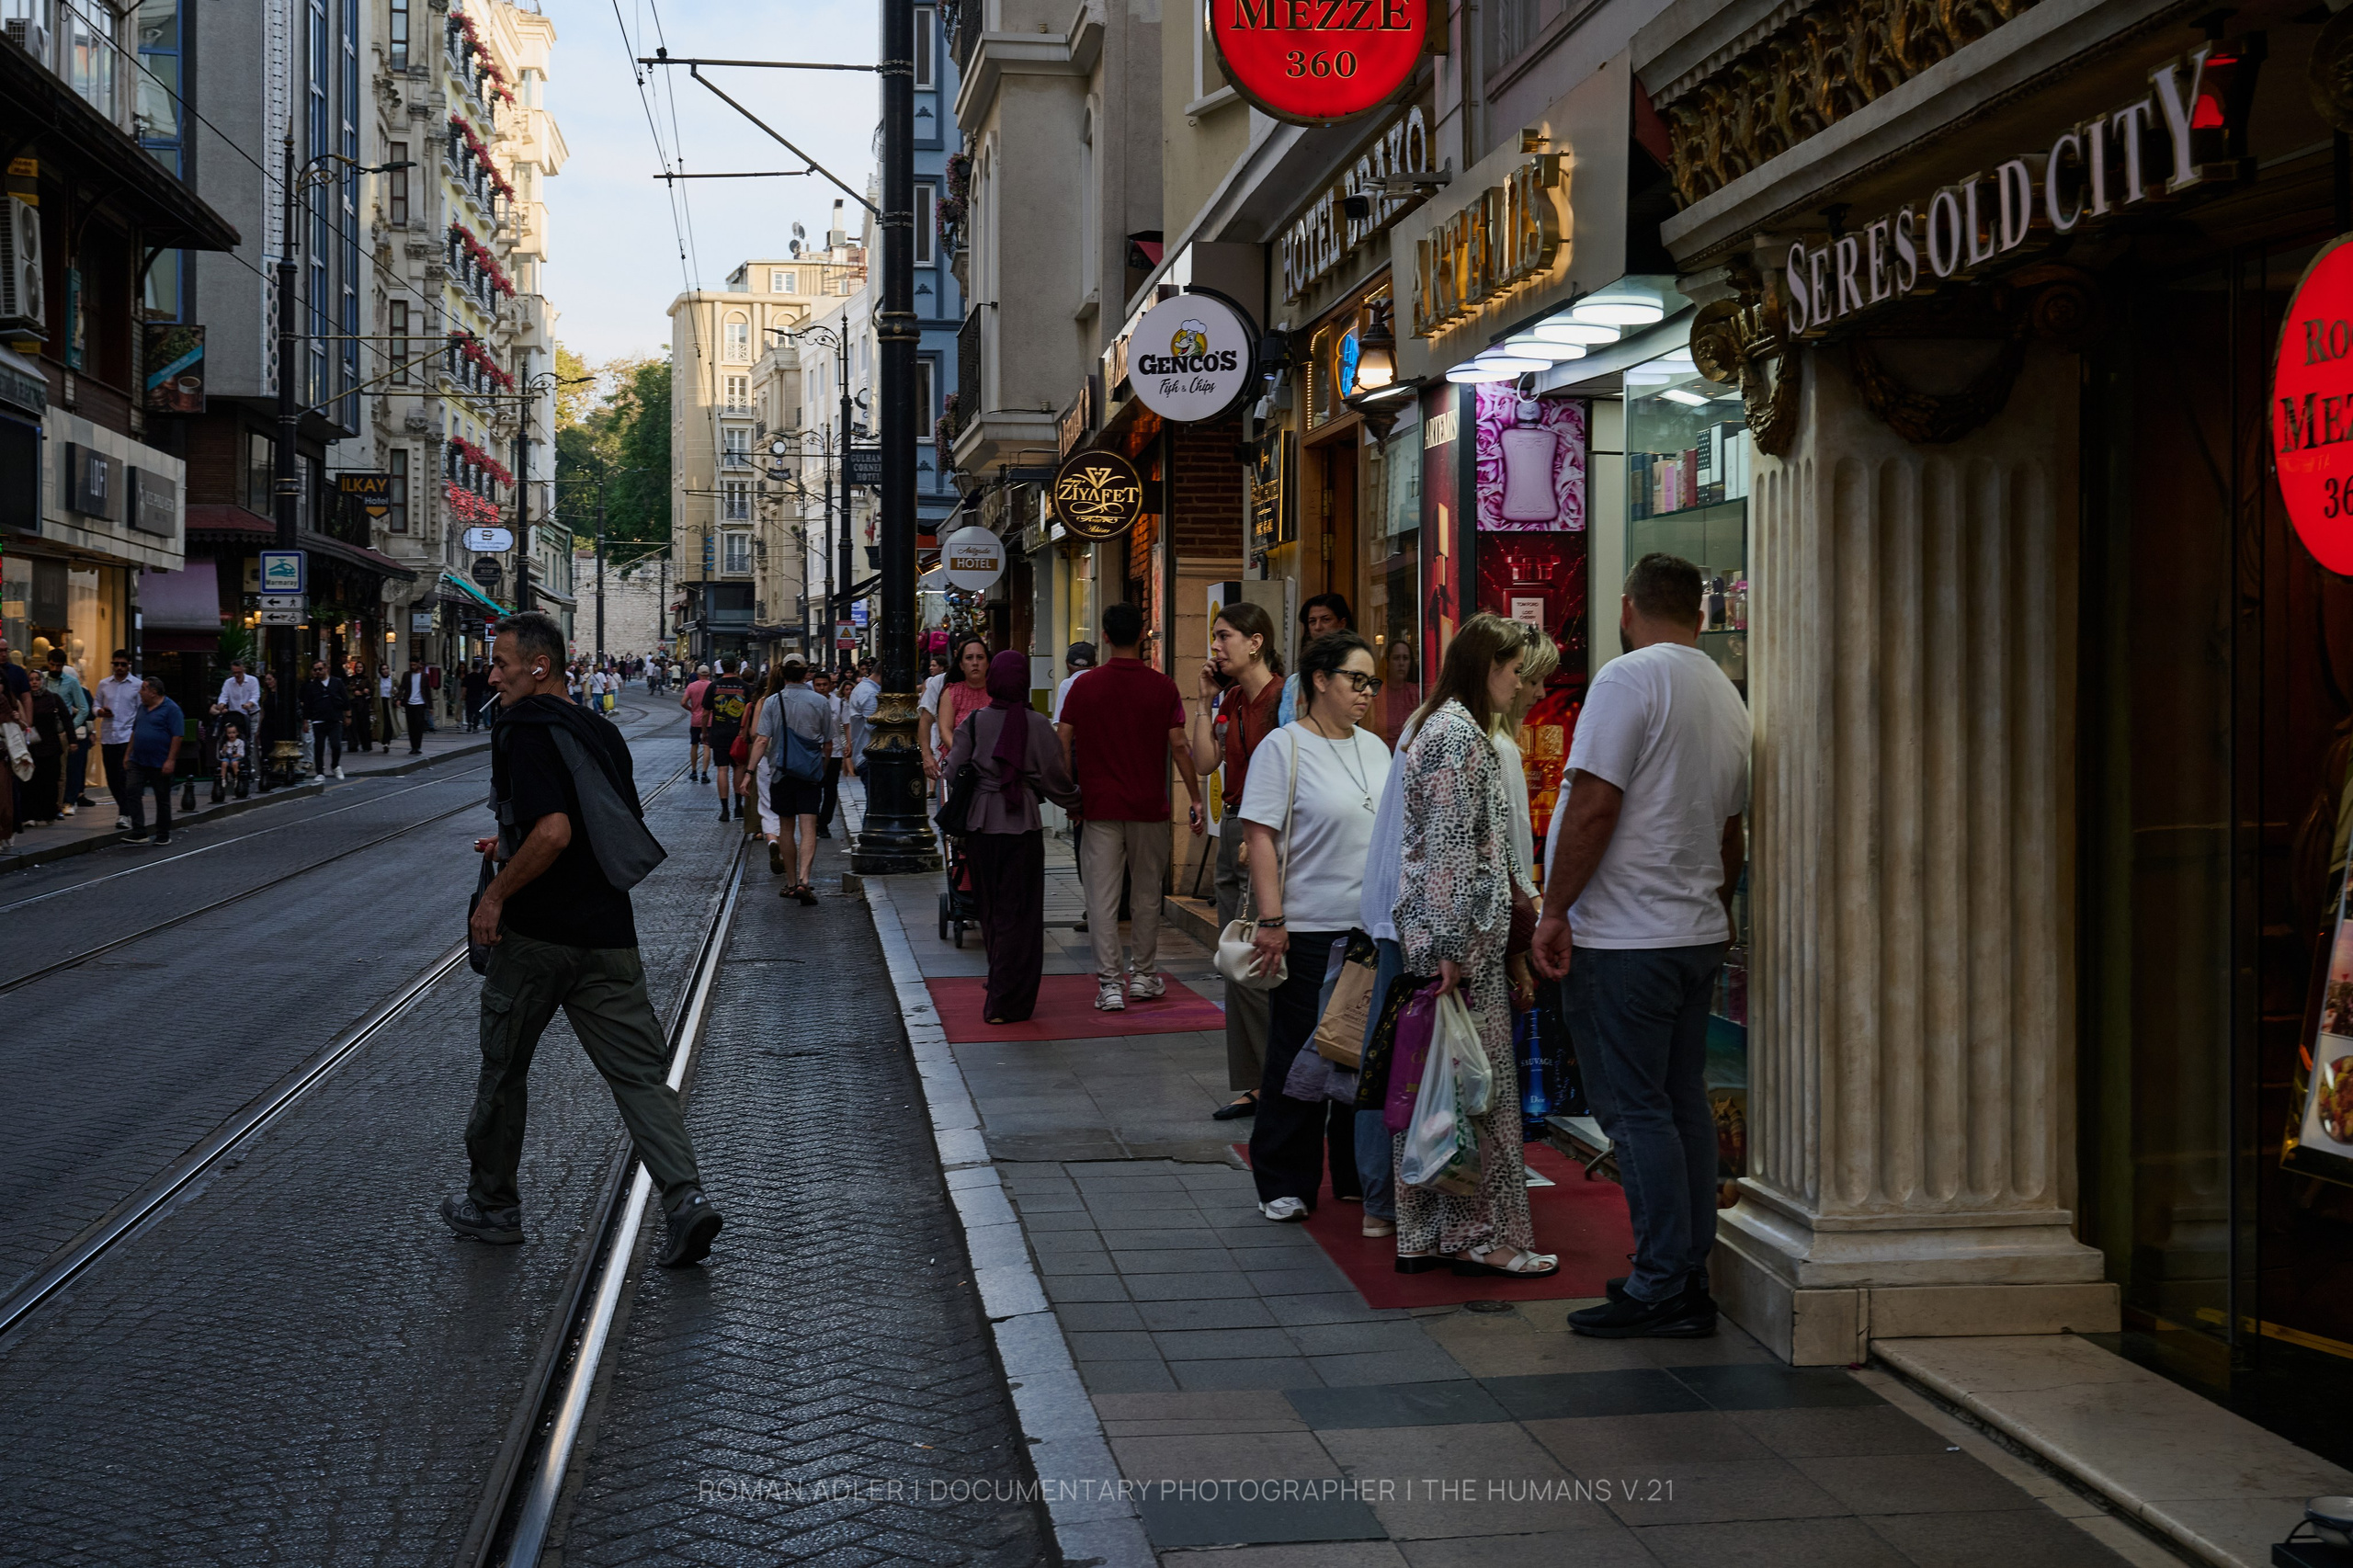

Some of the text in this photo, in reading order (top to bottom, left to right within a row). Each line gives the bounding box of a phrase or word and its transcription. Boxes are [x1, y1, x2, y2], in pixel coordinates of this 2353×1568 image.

[1229, 0, 1413, 31] MEZZE
[1285, 50, 1358, 79] 360
[1786, 48, 2210, 336] SERES OLD CITY
[1281, 187, 1340, 305] HOTEL
[2302, 318, 2353, 367] RO
[1138, 350, 1237, 375] GENCO'S
[1180, 384, 1188, 392] &
[1188, 375, 1217, 395] Chips
[341, 475, 388, 493] İLKAY
[364, 496, 389, 506] Hotel
[956, 558, 992, 569] HOTEL
[266, 579, 298, 587] Marmaray
[1520, 1057, 1553, 1068] SAUVAGE
[1529, 1095, 1546, 1104] Dior
